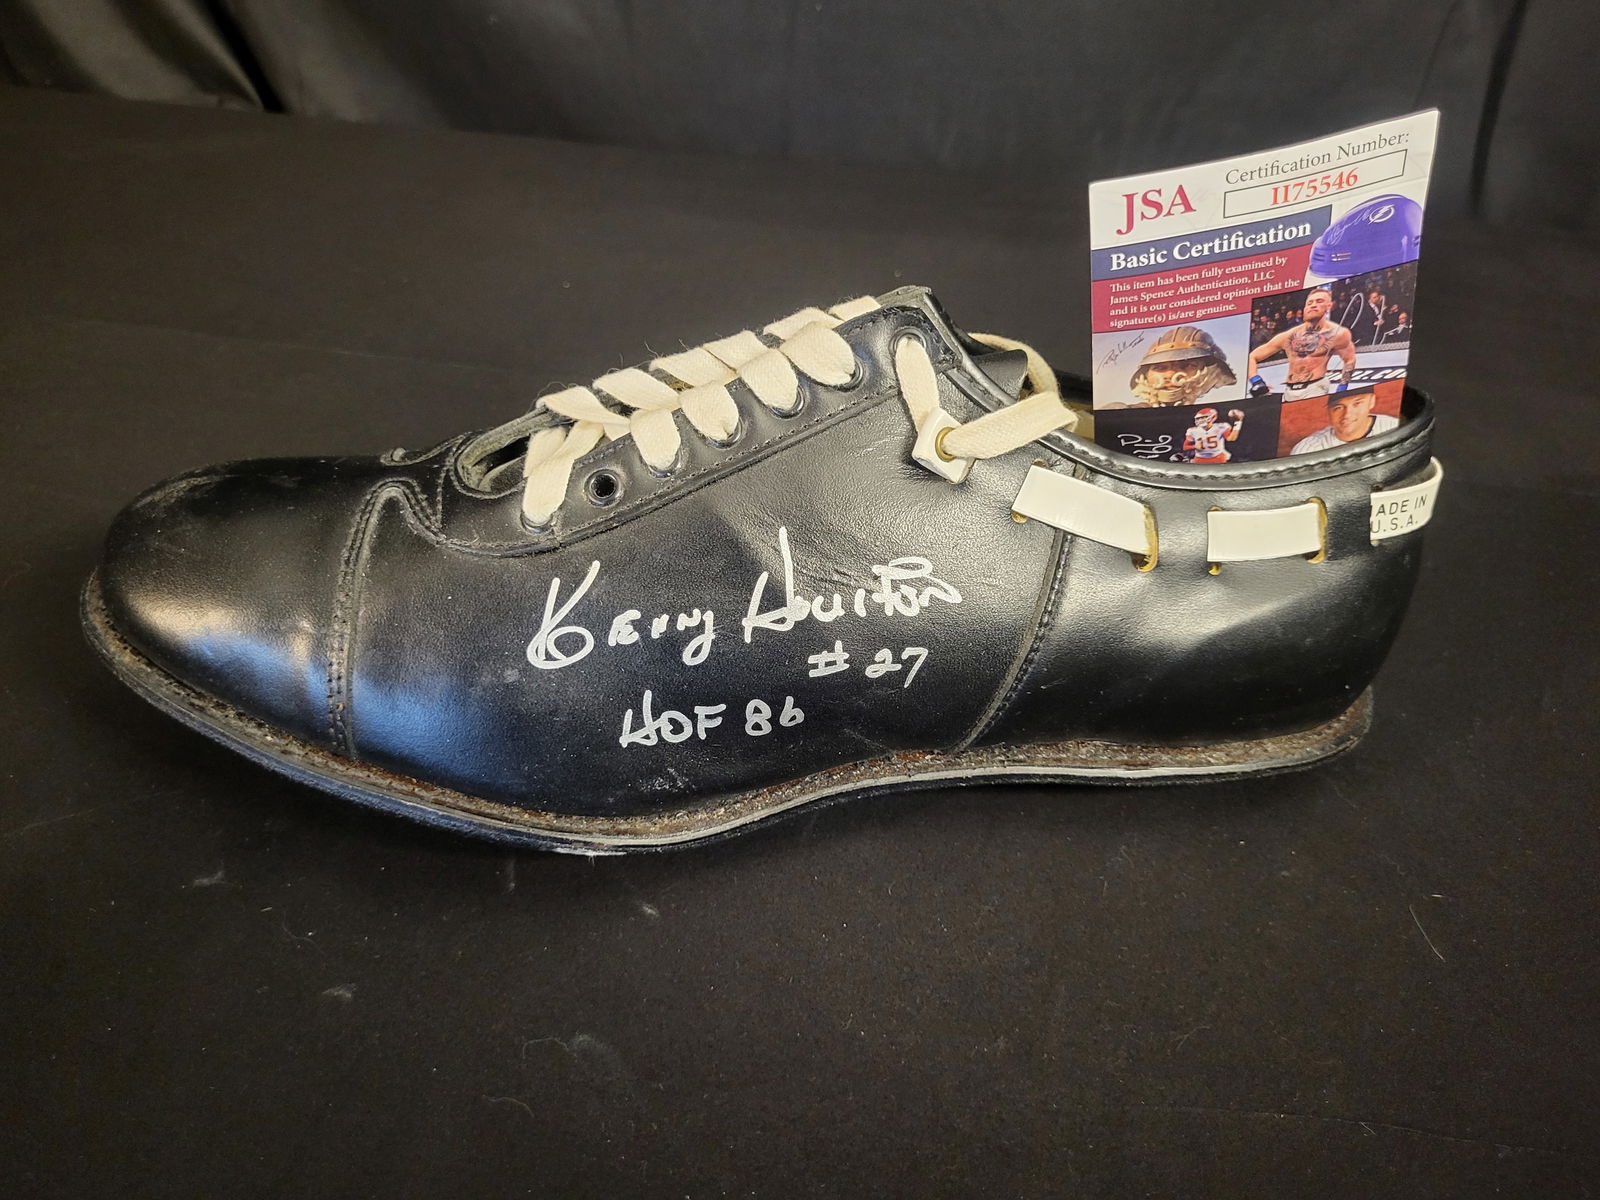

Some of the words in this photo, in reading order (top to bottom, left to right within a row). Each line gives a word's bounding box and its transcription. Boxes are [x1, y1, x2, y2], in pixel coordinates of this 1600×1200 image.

[1225, 152, 1331, 186] Certification
[1336, 131, 1410, 161] Number:
[1271, 168, 1359, 207] II75546
[1116, 184, 1197, 236] JSA
[1110, 248, 1168, 271] Basic
[1172, 222, 1312, 261] Certification
[1110, 283, 1131, 293] This
[1133, 280, 1155, 290] item
[1157, 274, 1174, 286] has
[1176, 270, 1199, 283] been
[1200, 267, 1223, 280] fully
[1225, 257, 1273, 275] examined
[1275, 255, 1288, 267] by
[1110, 295, 1138, 305] James
[1140, 289, 1175, 302] Spence
[1253, 270, 1276, 282] LLC
[1109, 314, 1166, 329] signature(s)
[1168, 309, 1194, 322] is/are
[1195, 303, 1237, 318] genuine.
[1110, 305, 1128, 316] and
[1130, 304, 1137, 314] it
[1140, 302, 1148, 313] is
[1149, 302, 1167, 312] our
[1168, 291, 1221, 309] considered
[1223, 286, 1261, 301] opinion
[1263, 282, 1283, 294] that
[1284, 278, 1300, 290] the
[1197, 435, 1218, 449] 15
[1371, 499, 1409, 517] ADE
[1414, 494, 1427, 510] IN
[865, 647, 929, 688] 27
[619, 690, 727, 748] HOF
[745, 696, 805, 737] 86
